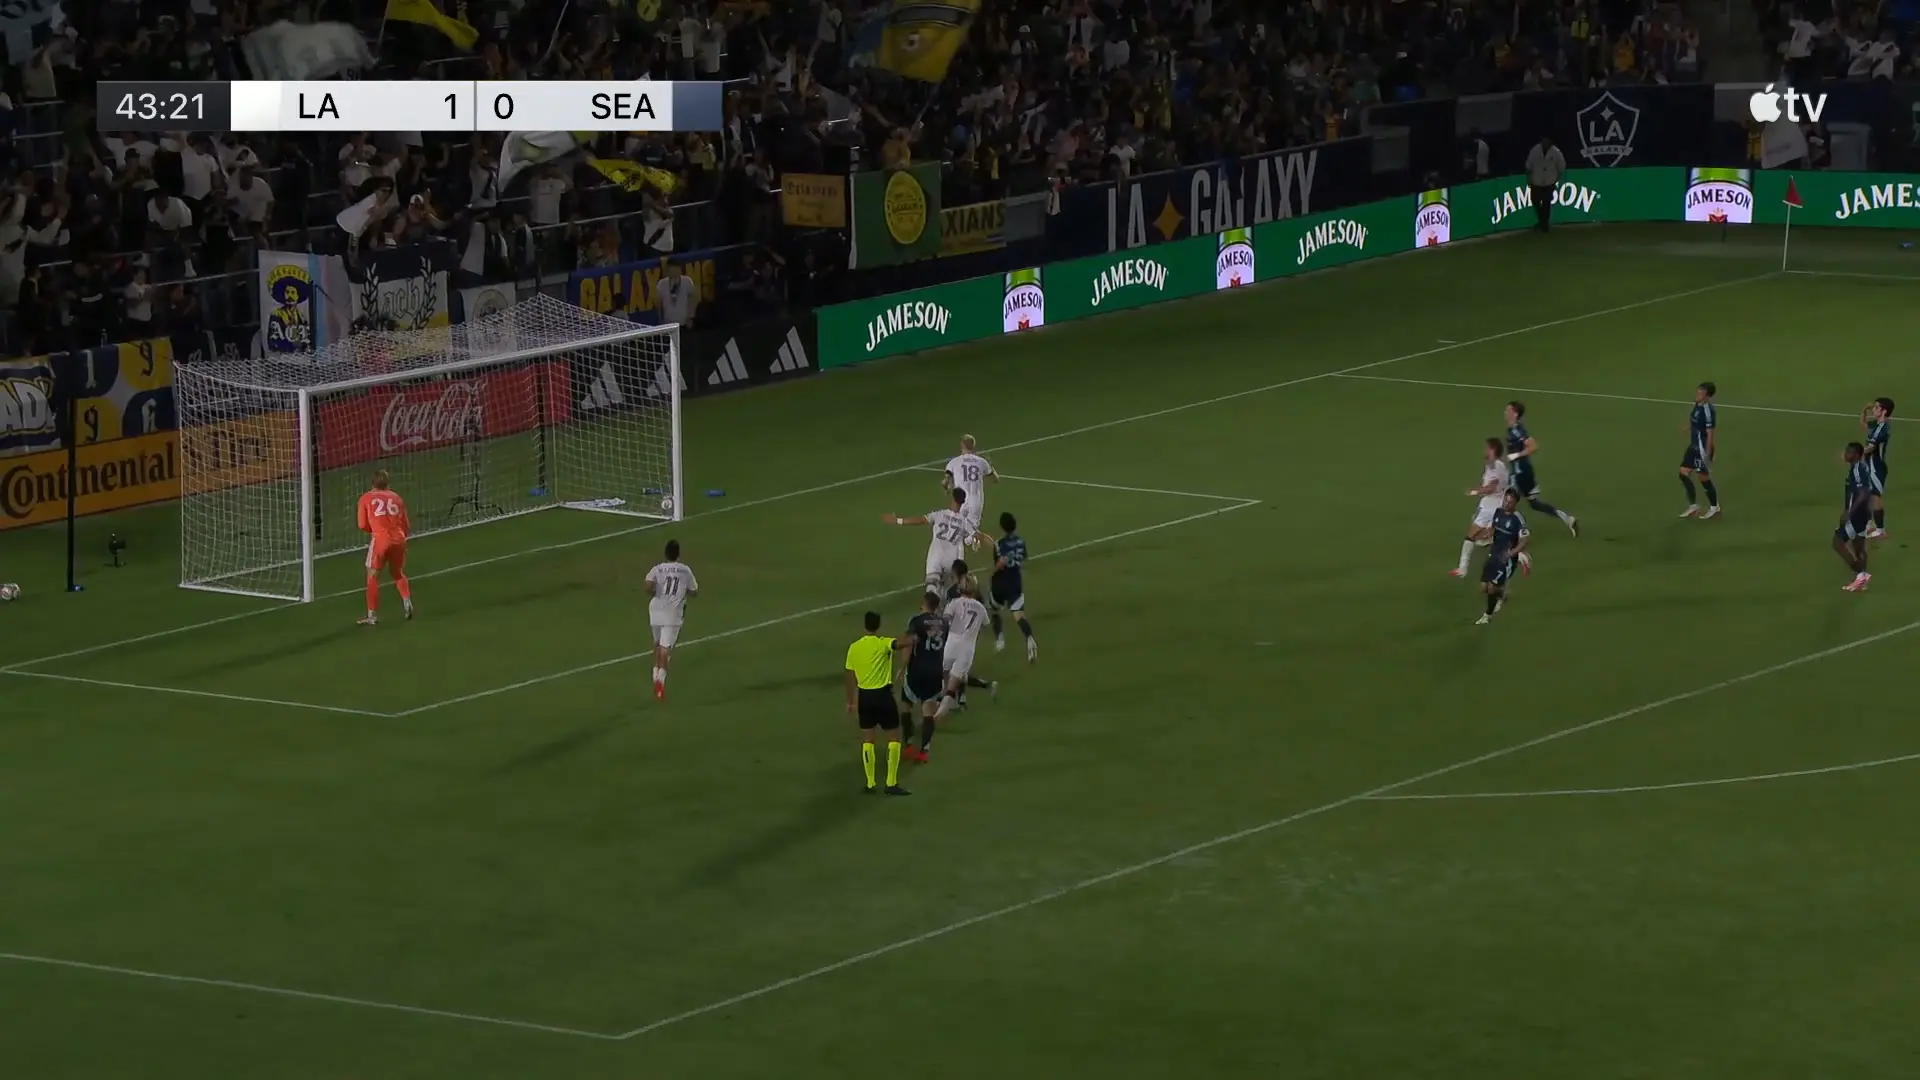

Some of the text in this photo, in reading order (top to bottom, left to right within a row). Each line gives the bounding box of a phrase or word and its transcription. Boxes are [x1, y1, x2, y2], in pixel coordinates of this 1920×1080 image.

[1590, 120, 1625, 142] LA
[1491, 182, 1597, 224] JAMSON
[1687, 189, 1751, 209] JAMESON
[941, 203, 1006, 237] XIANS
[1416, 210, 1449, 235] JAMESON
[1297, 219, 1367, 265] JAMESON
[1218, 251, 1253, 276] JAMESON
[1092, 259, 1167, 306] JAMESON
[1005, 293, 1042, 319] JAMESON
[866, 301, 949, 351] JAMESON
[1, 441, 174, 519] Contnental
[961, 464, 979, 482] 18
[371, 498, 400, 517] 26
[936, 522, 961, 543] 27
[664, 576, 680, 595] 11
[967, 610, 978, 630] 7
